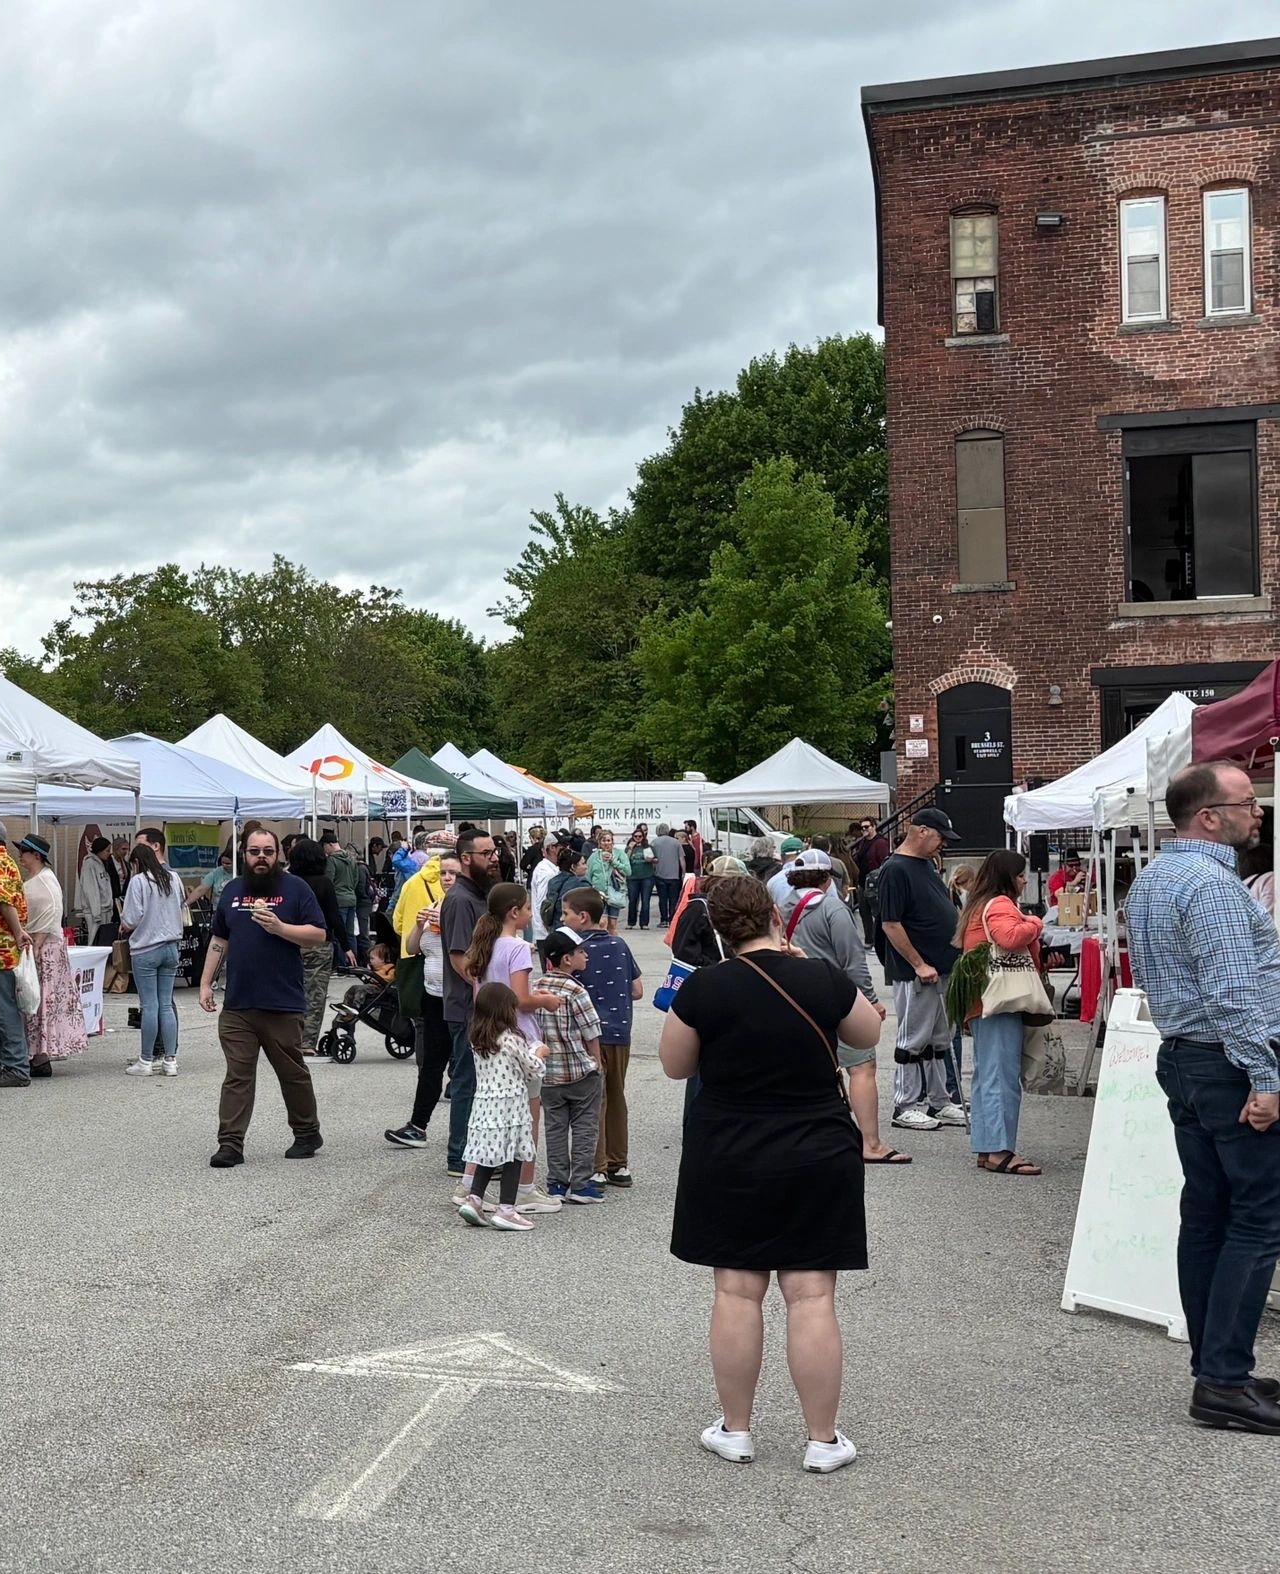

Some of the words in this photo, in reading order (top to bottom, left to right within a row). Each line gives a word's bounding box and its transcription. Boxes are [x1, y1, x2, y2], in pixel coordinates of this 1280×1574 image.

[1171, 689, 1199, 698] ITE
[1200, 688, 1216, 698] 150
[983, 731, 992, 742] 3
[624, 807, 662, 820] FARMS
